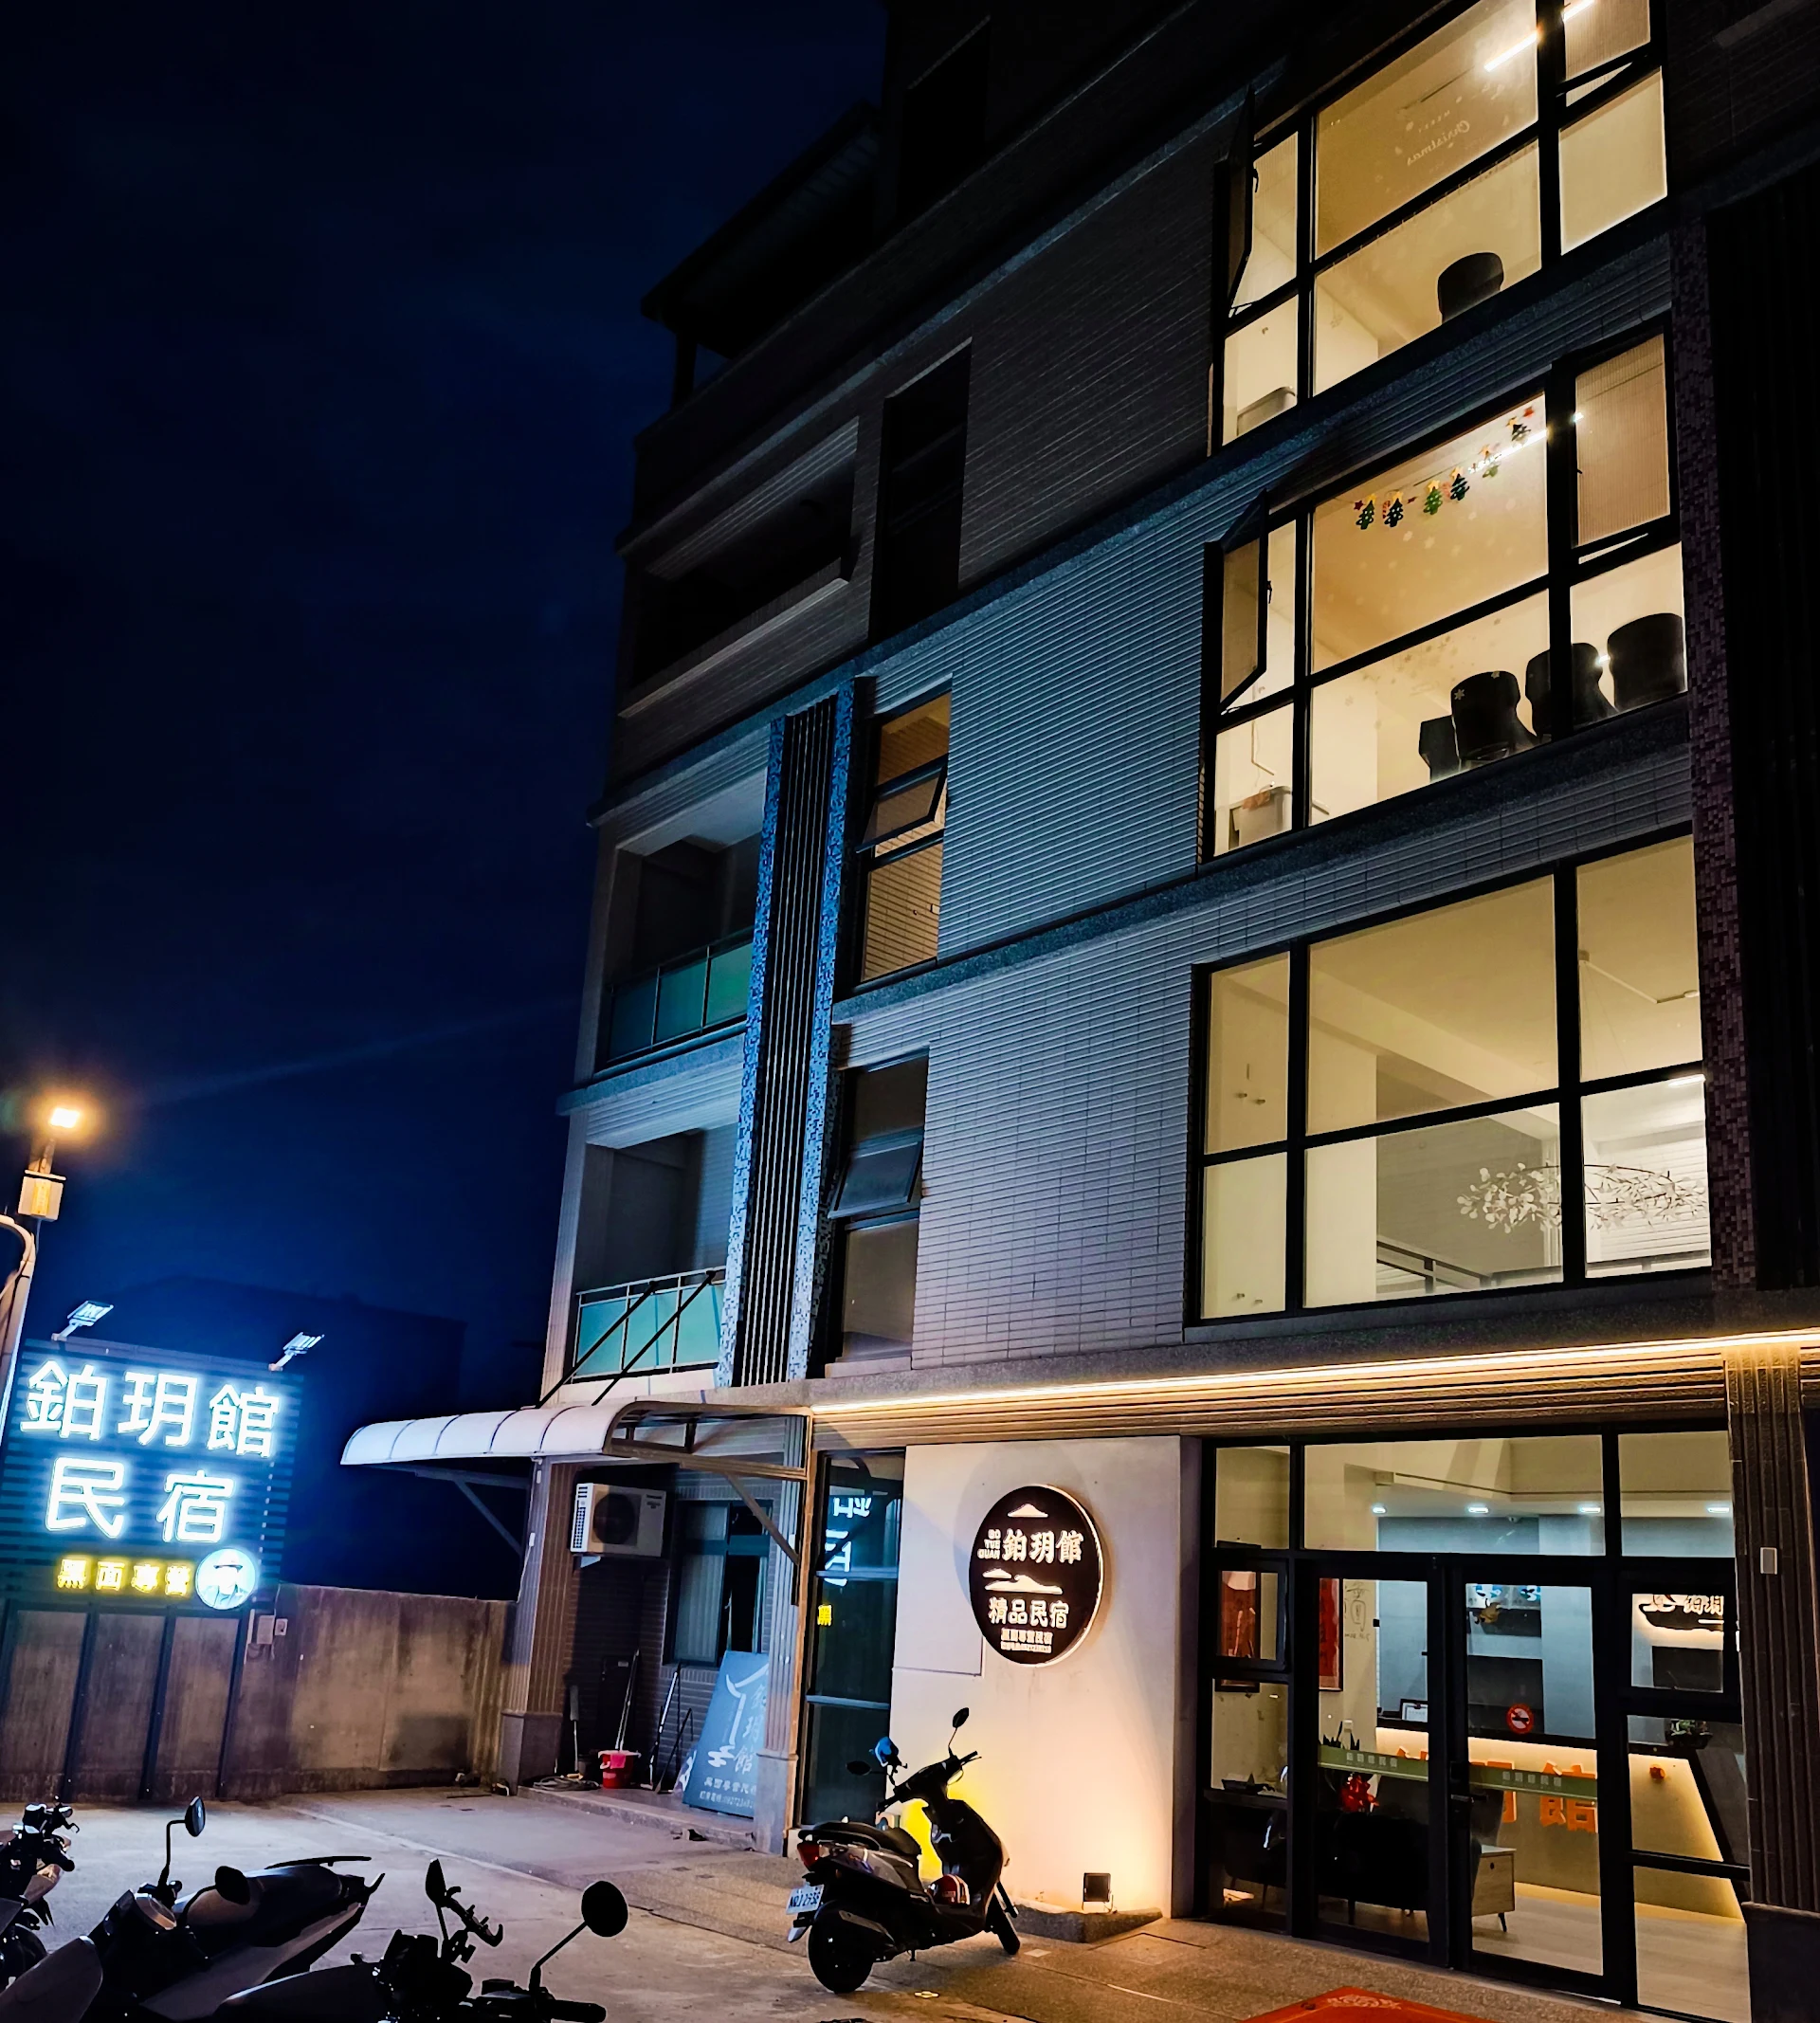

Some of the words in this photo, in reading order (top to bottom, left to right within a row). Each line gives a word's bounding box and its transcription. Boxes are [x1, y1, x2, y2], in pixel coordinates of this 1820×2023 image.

[20, 1360, 281, 1457] 鉑玥館
[46, 1457, 235, 1543] 民宿
[1002, 1528, 1083, 1564] 鉑玥館
[988, 1596, 1069, 1629] 精品民宿
